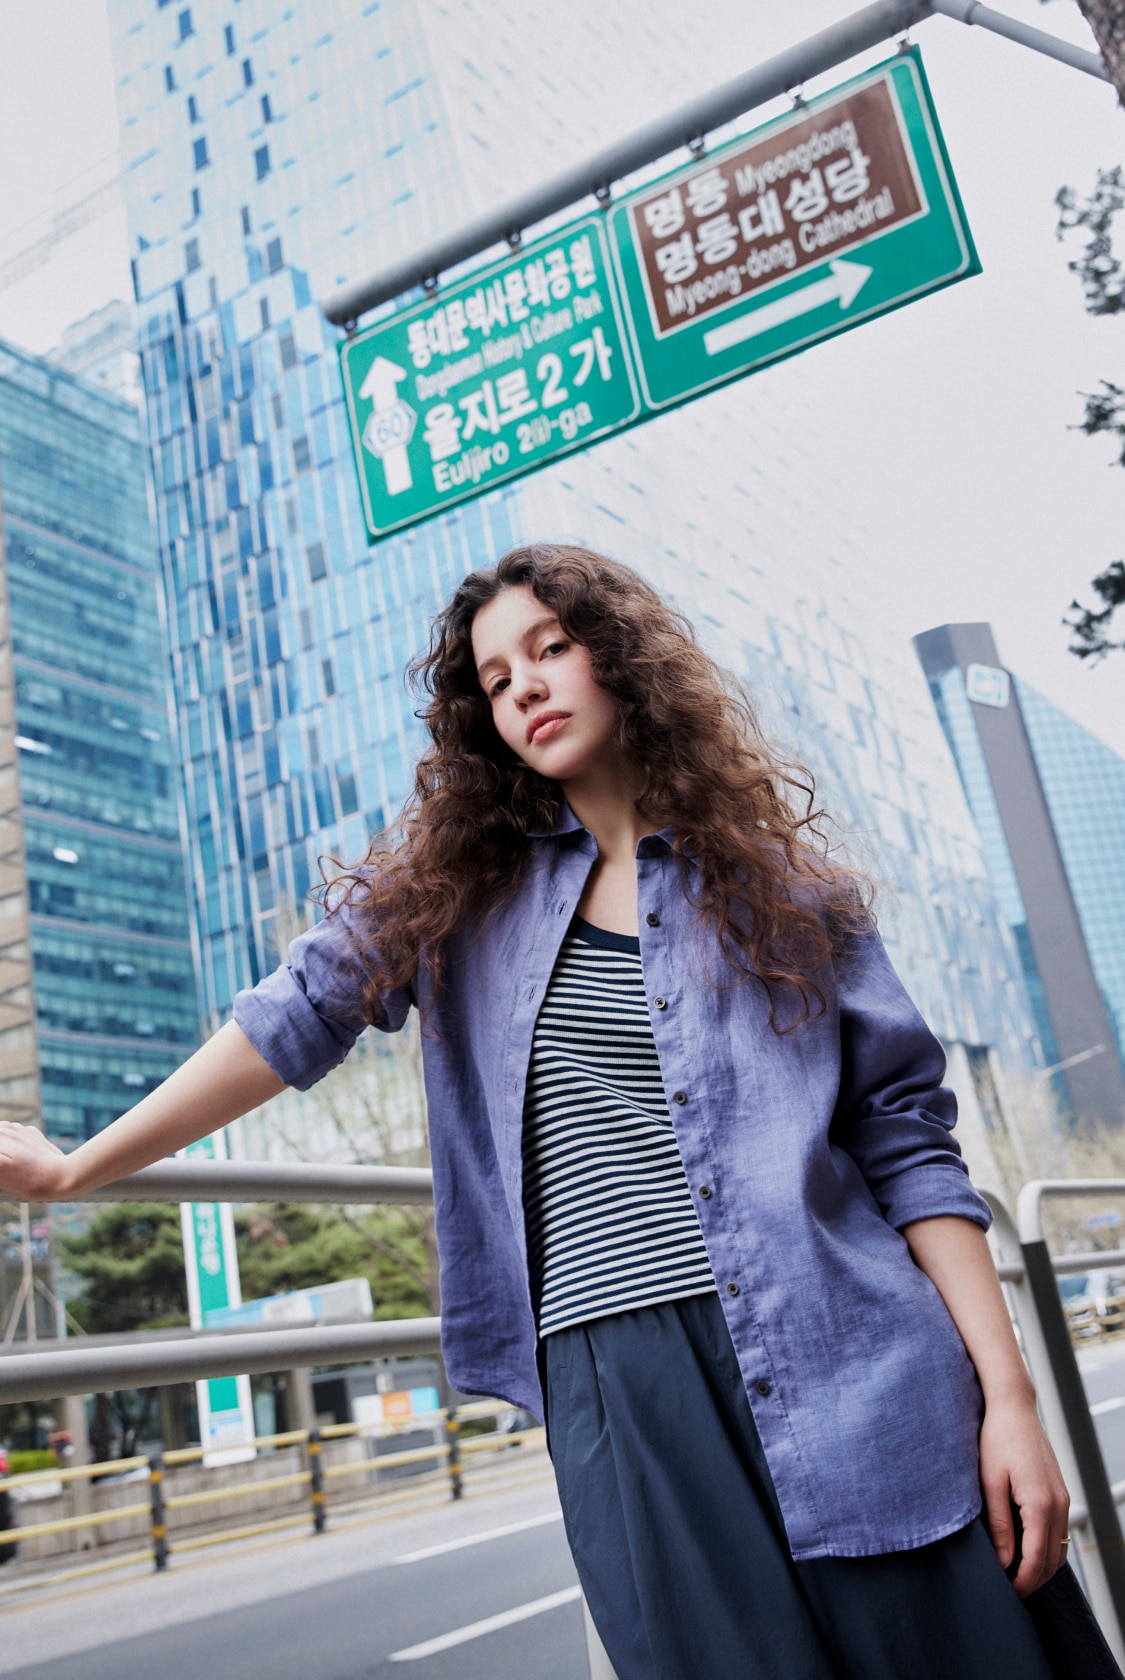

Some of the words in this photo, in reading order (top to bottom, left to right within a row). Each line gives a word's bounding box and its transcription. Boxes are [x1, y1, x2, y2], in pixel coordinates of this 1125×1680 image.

[643, 168, 729, 239] 명동
[734, 120, 859, 197] Myeongdong
[655, 148, 870, 285] 명동대성당
[664, 238, 797, 318] Myeong-dong
[799, 185, 895, 252] Cathedral
[572, 288, 605, 324] Park
[376, 411, 402, 443] 60
[431, 440, 510, 493] Euljiro
